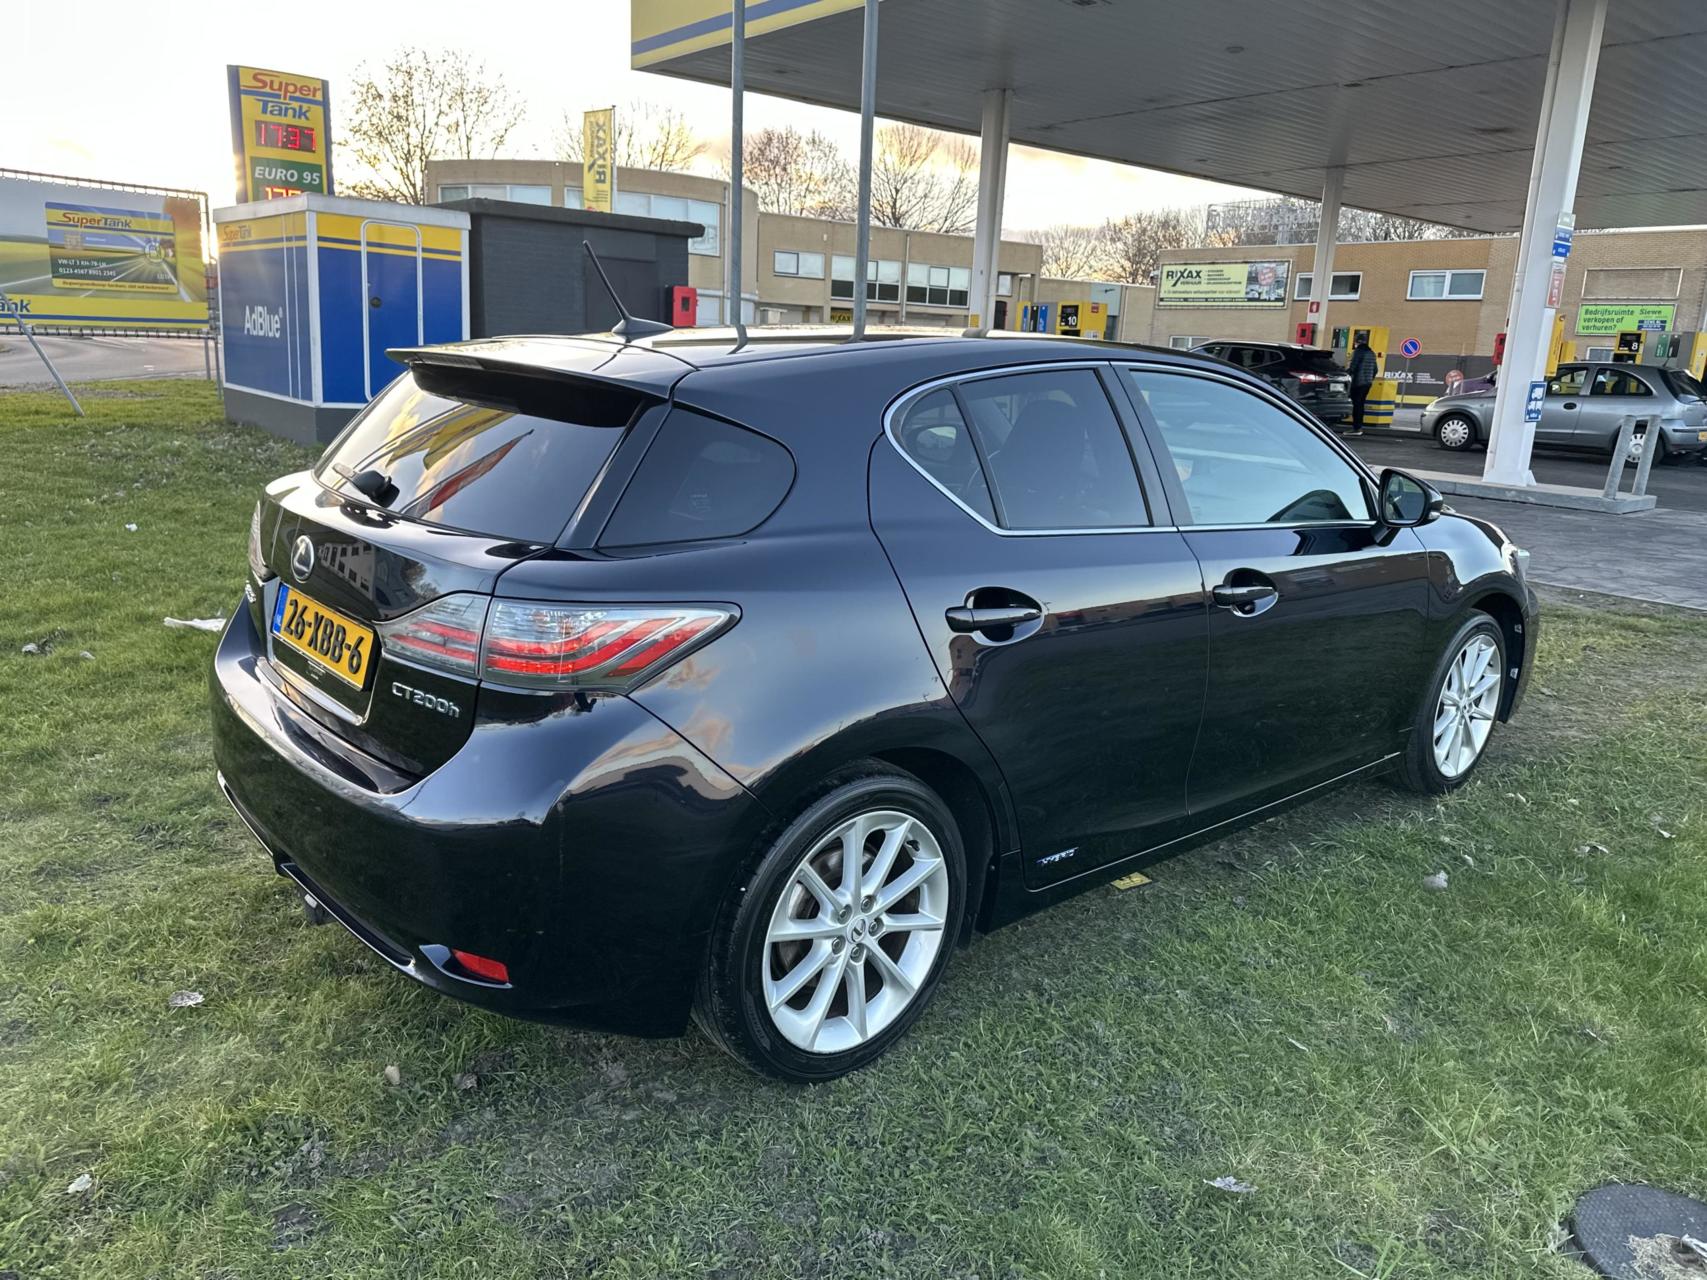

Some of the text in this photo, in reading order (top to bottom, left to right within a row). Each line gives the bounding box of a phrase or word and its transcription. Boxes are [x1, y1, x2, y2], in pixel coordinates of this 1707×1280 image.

[240, 72, 321, 101] Super
[255, 98, 311, 120] Tank
[261, 124, 317, 151] 17:37
[254, 166, 321, 184] EURO 95
[56, 212, 133, 228] SuperTank
[1166, 268, 1202, 287] RIXAX
[1067, 316, 1077, 325] 10
[1583, 316, 1615, 324] verkopen
[1584, 308, 1634, 317] Bedrijfsruimte
[1631, 342, 1638, 350] 8
[283, 598, 365, 675] 26-XBB-6
[392, 681, 460, 719] CT200h
